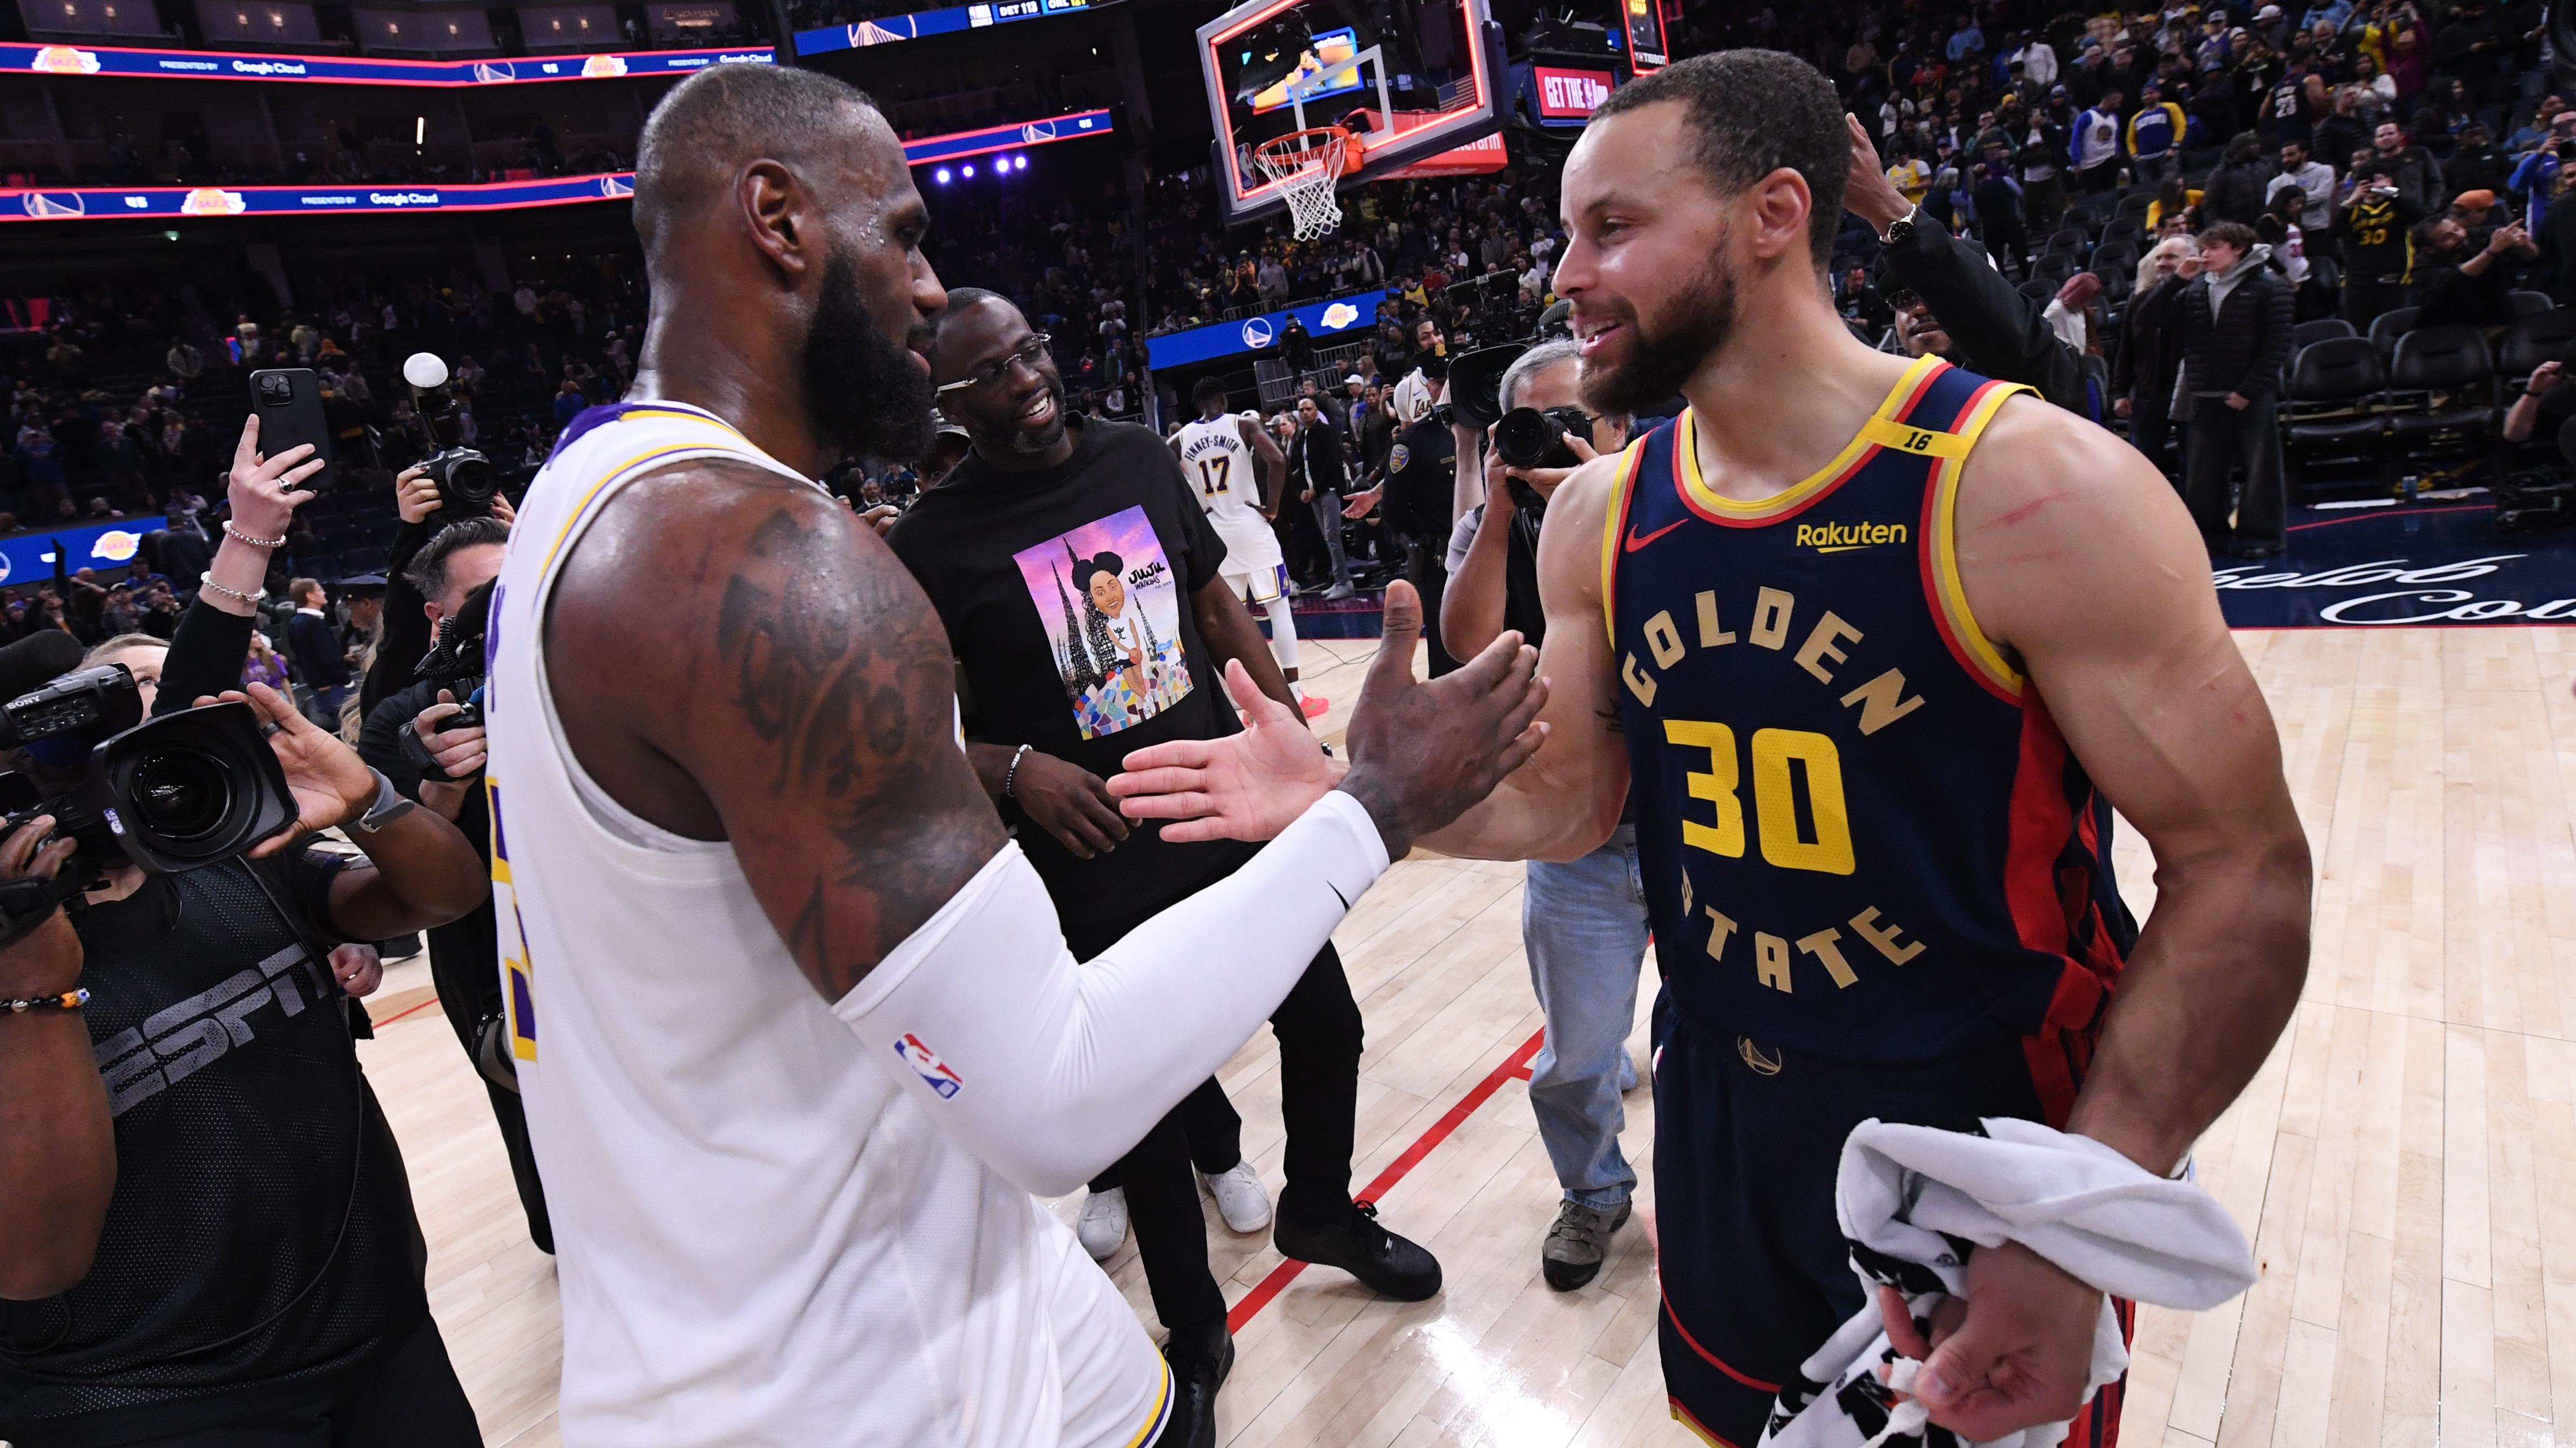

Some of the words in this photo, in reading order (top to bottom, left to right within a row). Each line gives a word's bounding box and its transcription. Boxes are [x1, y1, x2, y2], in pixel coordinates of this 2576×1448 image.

[1000, 4, 1020, 17] DET
[1020, 1, 1039, 14] 113
[1314, 35, 1347, 49] verizon
[232, 60, 274, 75] Google
[273, 62, 306, 75] Cloud
[719, 55, 749, 64] Google
[748, 53, 773, 63] Cloud
[1643, 52, 1667, 65] TISSOT
[1544, 76, 1566, 108] GET
[1563, 77, 1586, 109] THE
[370, 193, 409, 206] Google
[408, 193, 439, 204] Cloud
[1184, 435, 1240, 462] FINNEY-SMITH
[1904, 431, 1933, 451] 16
[1197, 454, 1231, 497] 17
[1796, 520, 1908, 547] Rakuten
[2319, 589, 2576, 625] Cou
[1622, 586, 1926, 736] GOLDEN
[6, 695, 41, 710] SONY
[1662, 719, 1856, 876] 30
[1681, 864, 1927, 994] STATE
[92, 942, 329, 1119] ESPN
